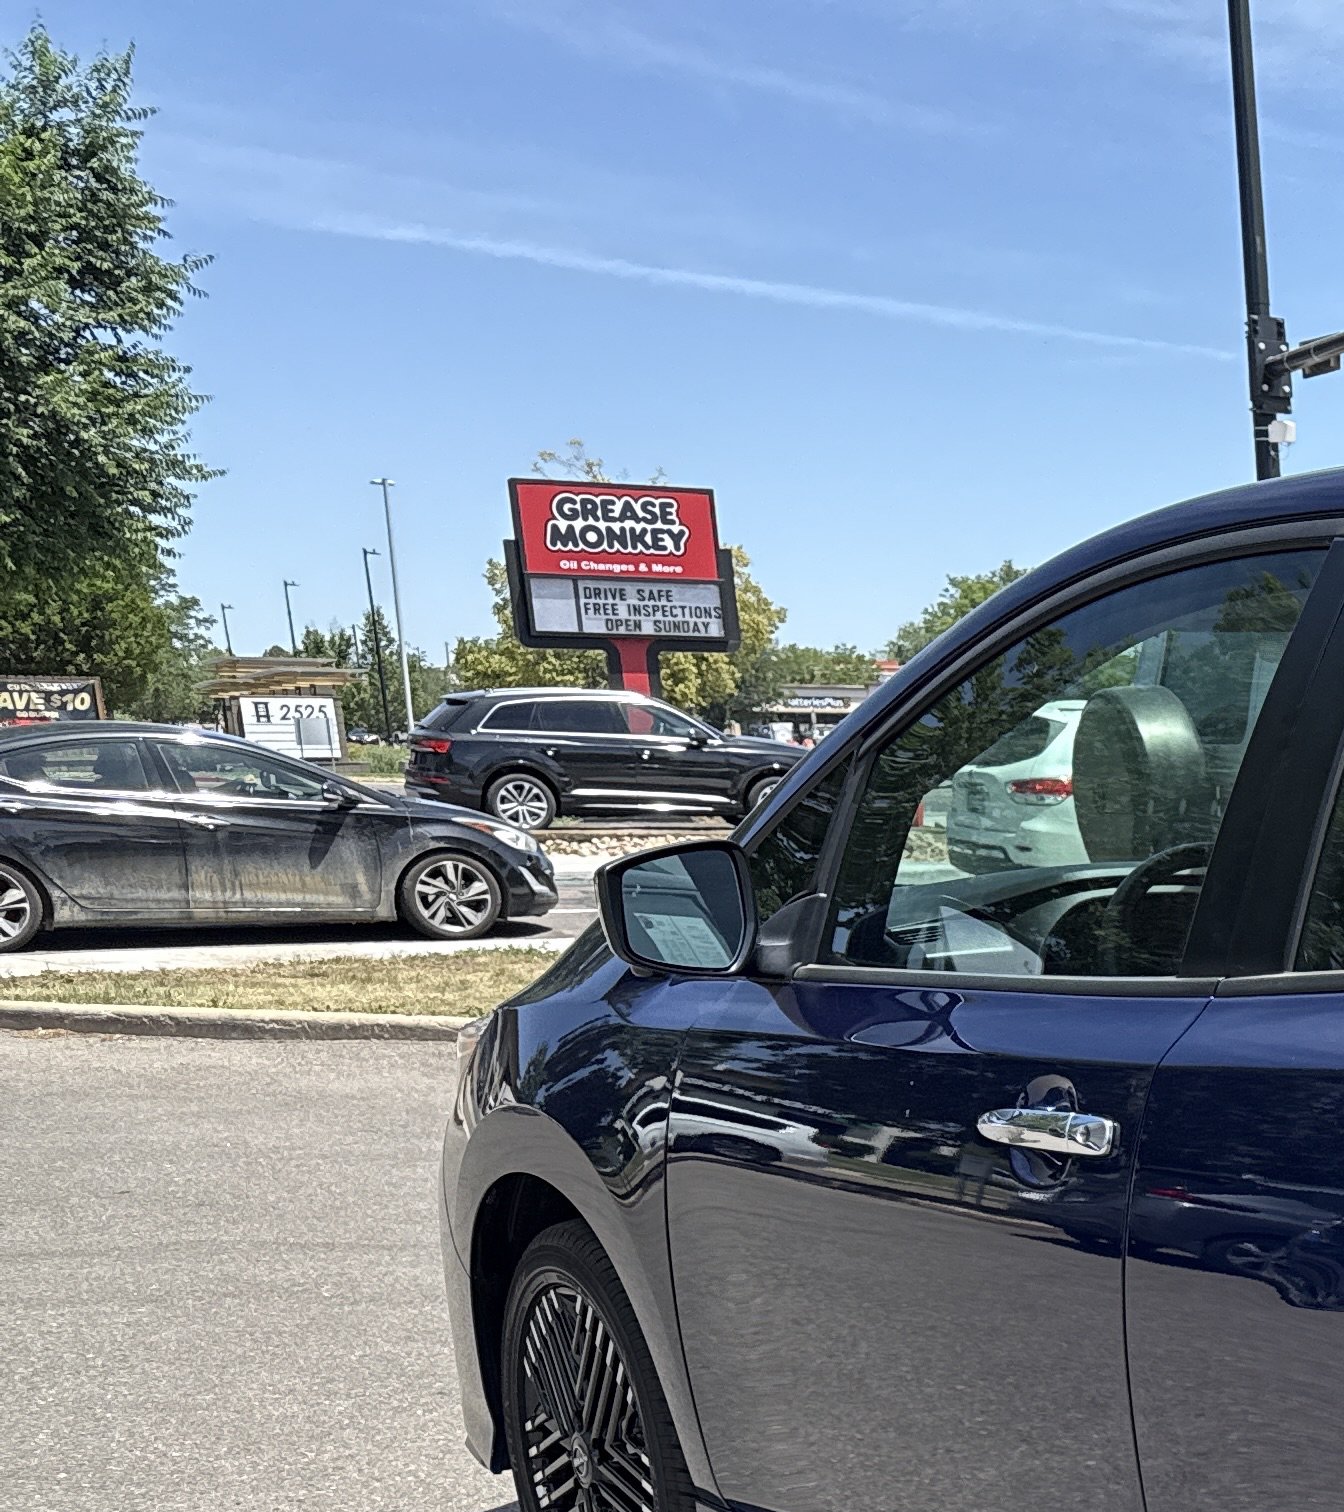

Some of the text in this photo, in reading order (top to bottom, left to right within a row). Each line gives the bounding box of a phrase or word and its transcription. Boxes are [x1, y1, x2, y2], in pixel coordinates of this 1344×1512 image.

[554, 495, 678, 526] GREASE
[549, 523, 687, 553] MONKEY
[559, 560, 684, 574] Oil Changes & More
[584, 586, 674, 603] DRIVE SAFE
[584, 602, 723, 620] FREE INSPECTIONS
[605, 618, 711, 635] OPEN SUNDAY
[0, 691, 92, 711] AVE $10
[280, 704, 328, 719] 2525
